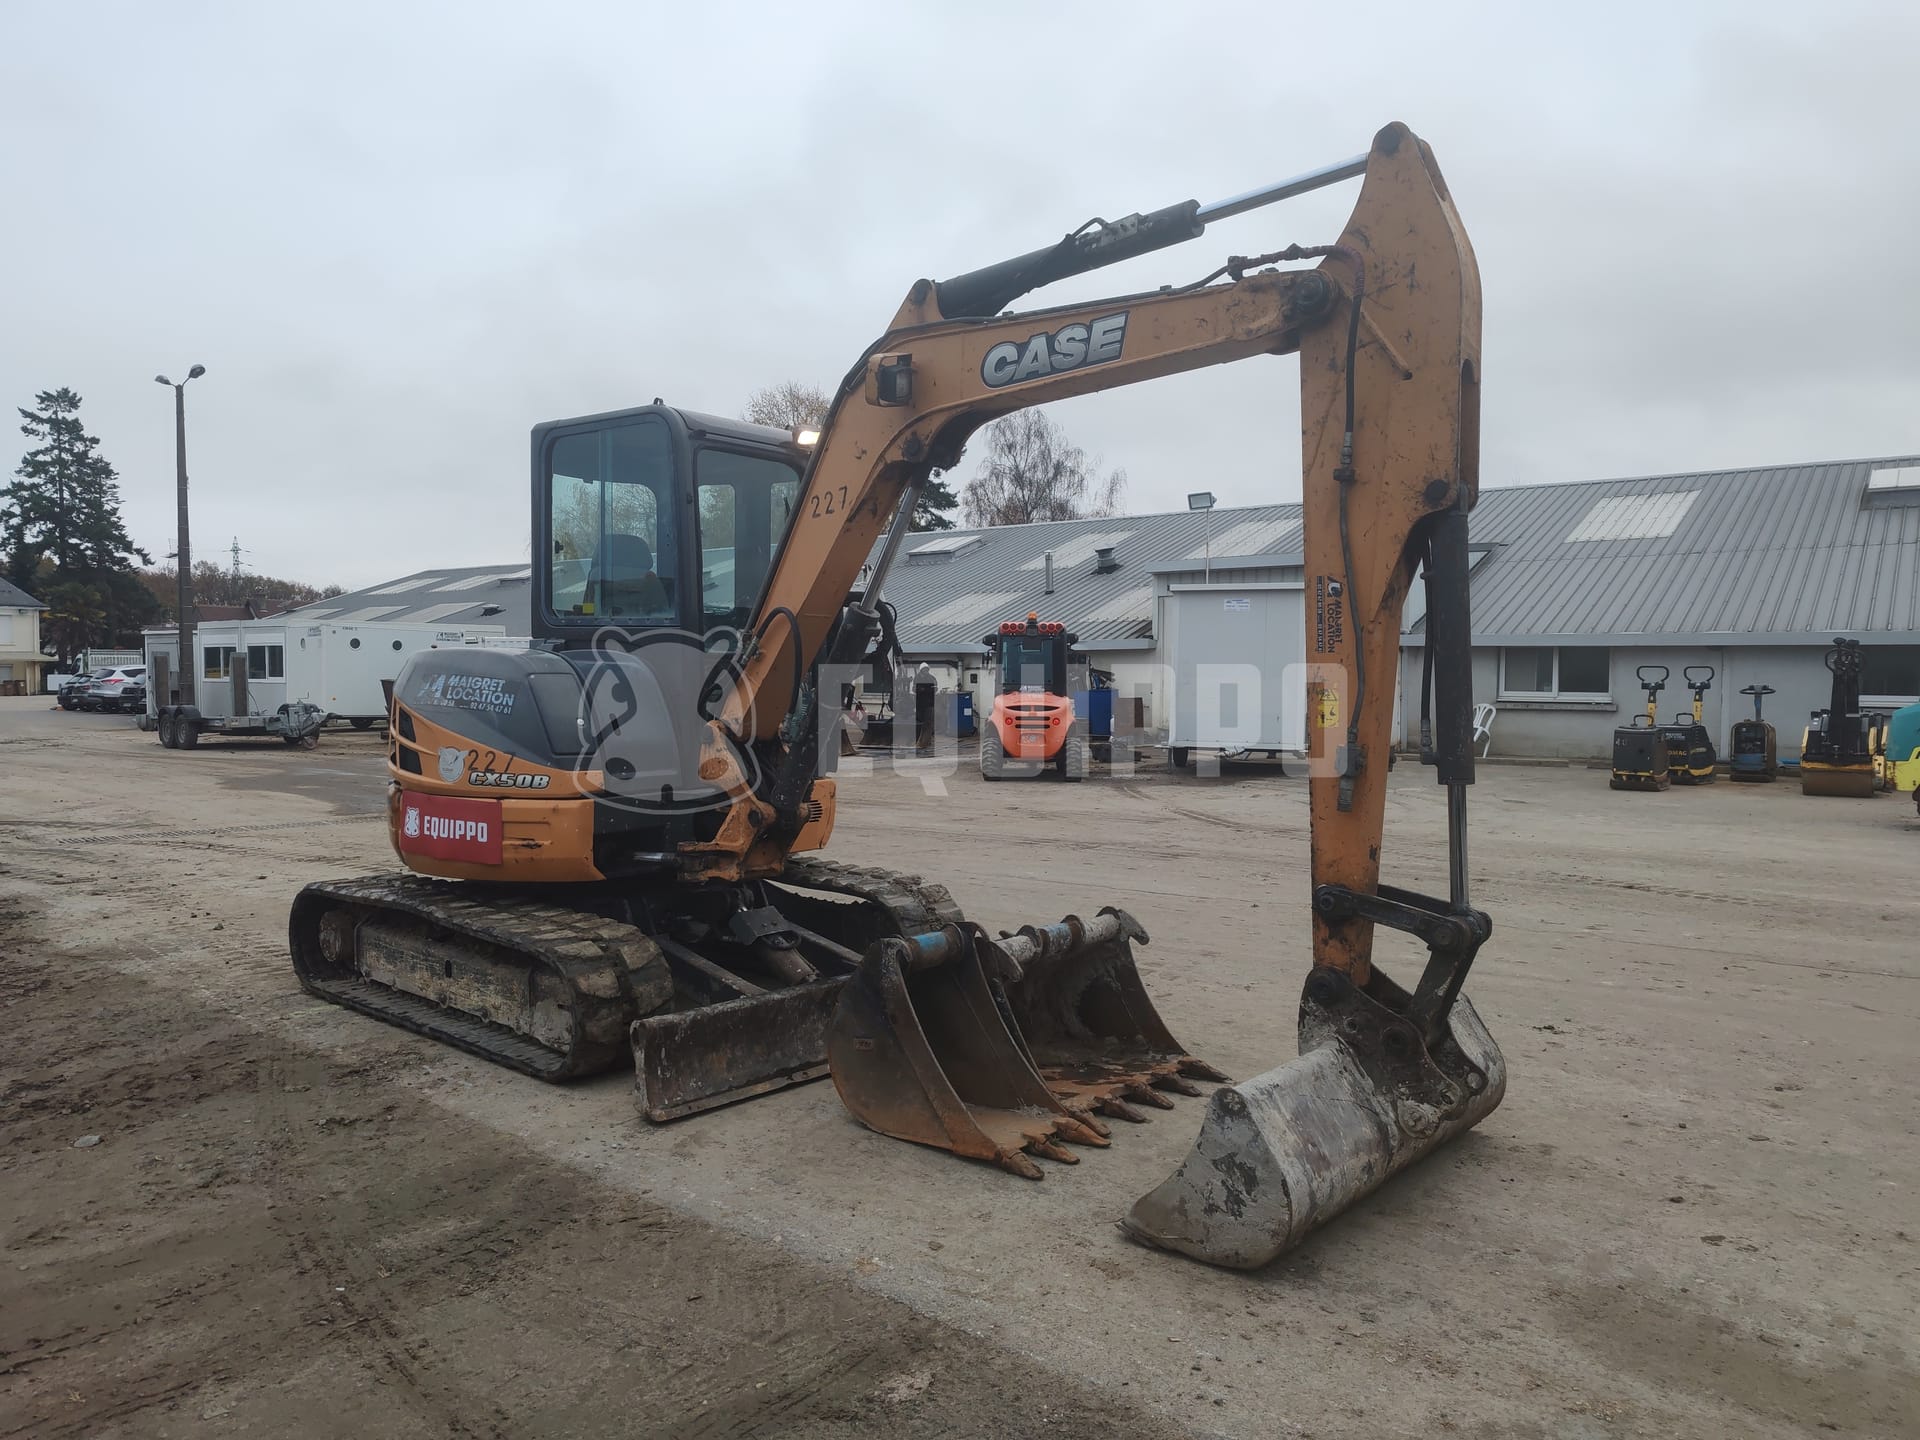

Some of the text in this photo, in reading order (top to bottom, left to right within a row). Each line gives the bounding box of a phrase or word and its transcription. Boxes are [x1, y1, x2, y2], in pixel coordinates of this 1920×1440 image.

[981, 310, 1130, 388] CASE
[810, 485, 848, 518] 227
[1327, 603, 1335, 653] LOCATION
[446, 687, 515, 706] LOCATION
[448, 674, 506, 692] MAIGRET
[468, 771, 551, 789] CX50B
[423, 815, 488, 843] EQUIPPO
